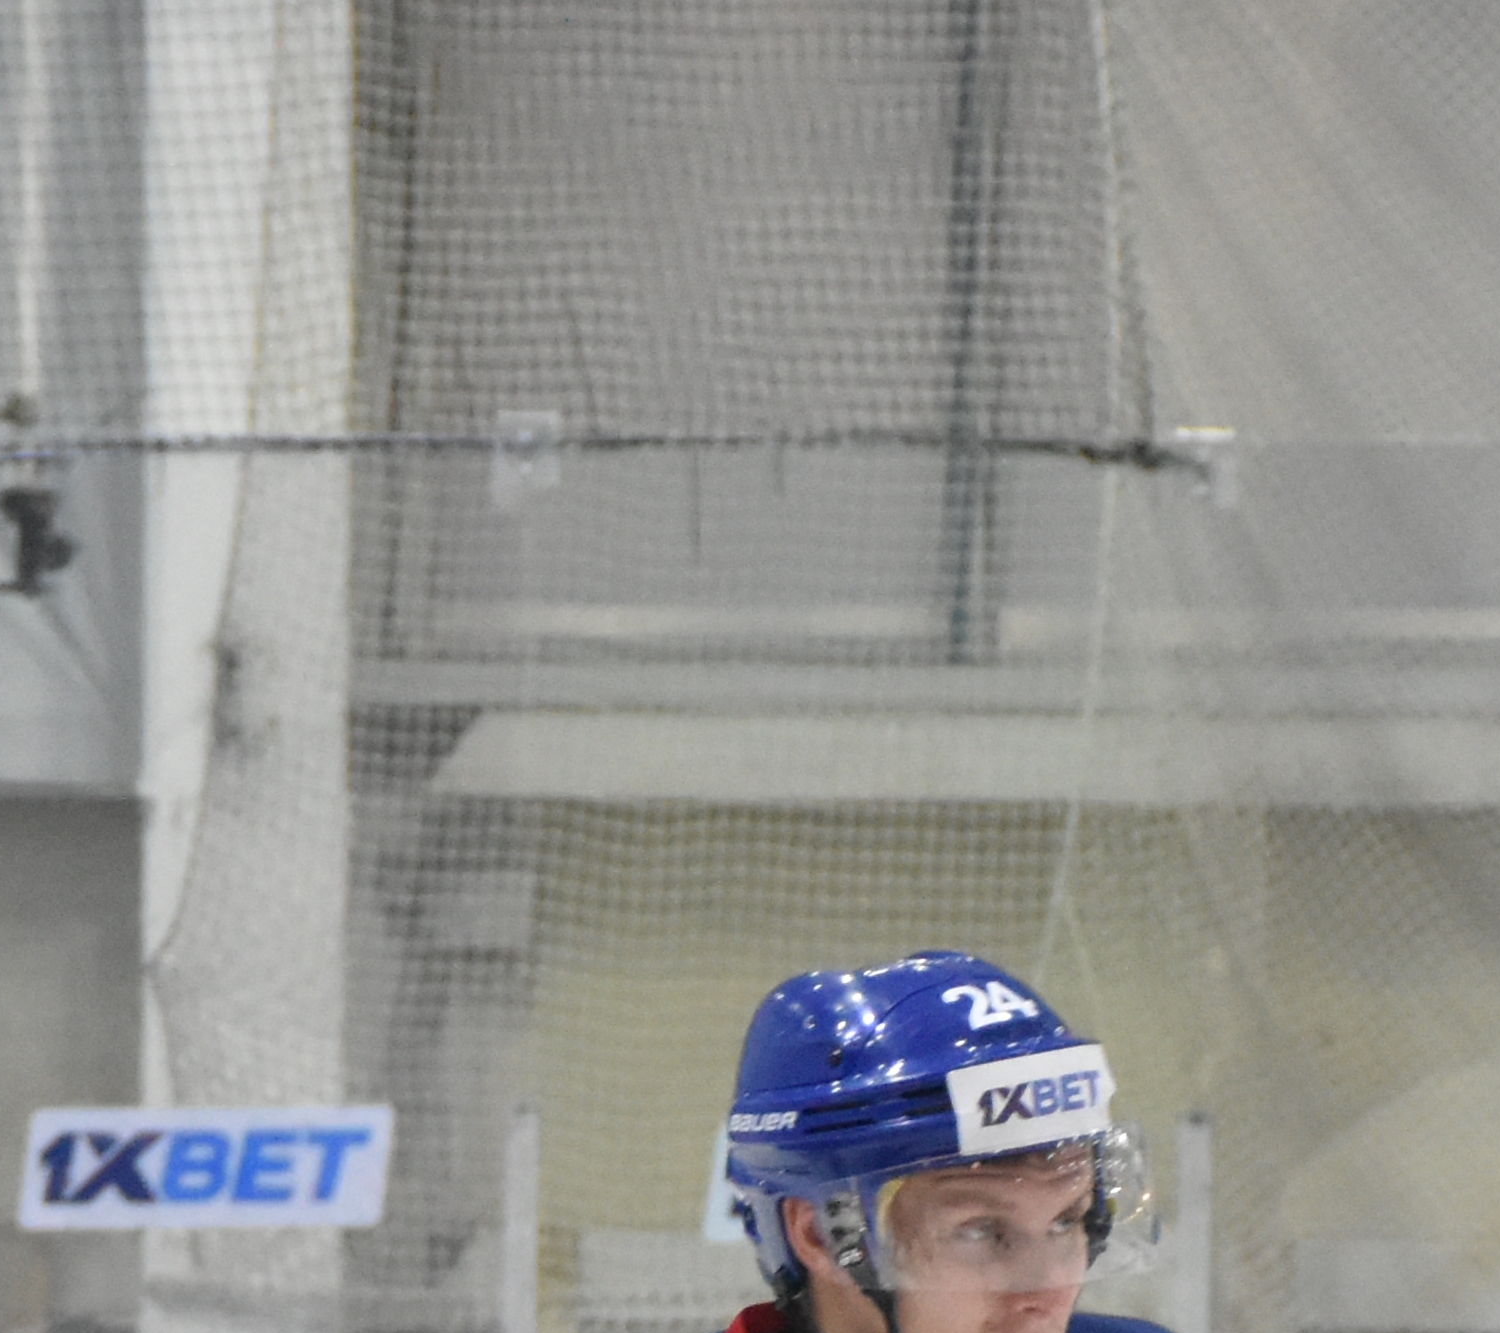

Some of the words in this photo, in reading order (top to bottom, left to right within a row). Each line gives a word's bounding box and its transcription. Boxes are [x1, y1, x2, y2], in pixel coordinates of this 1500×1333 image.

[942, 981, 1039, 1031] 24
[977, 1070, 1101, 1127] 1XBET
[38, 1129, 372, 1205] 1XBET
